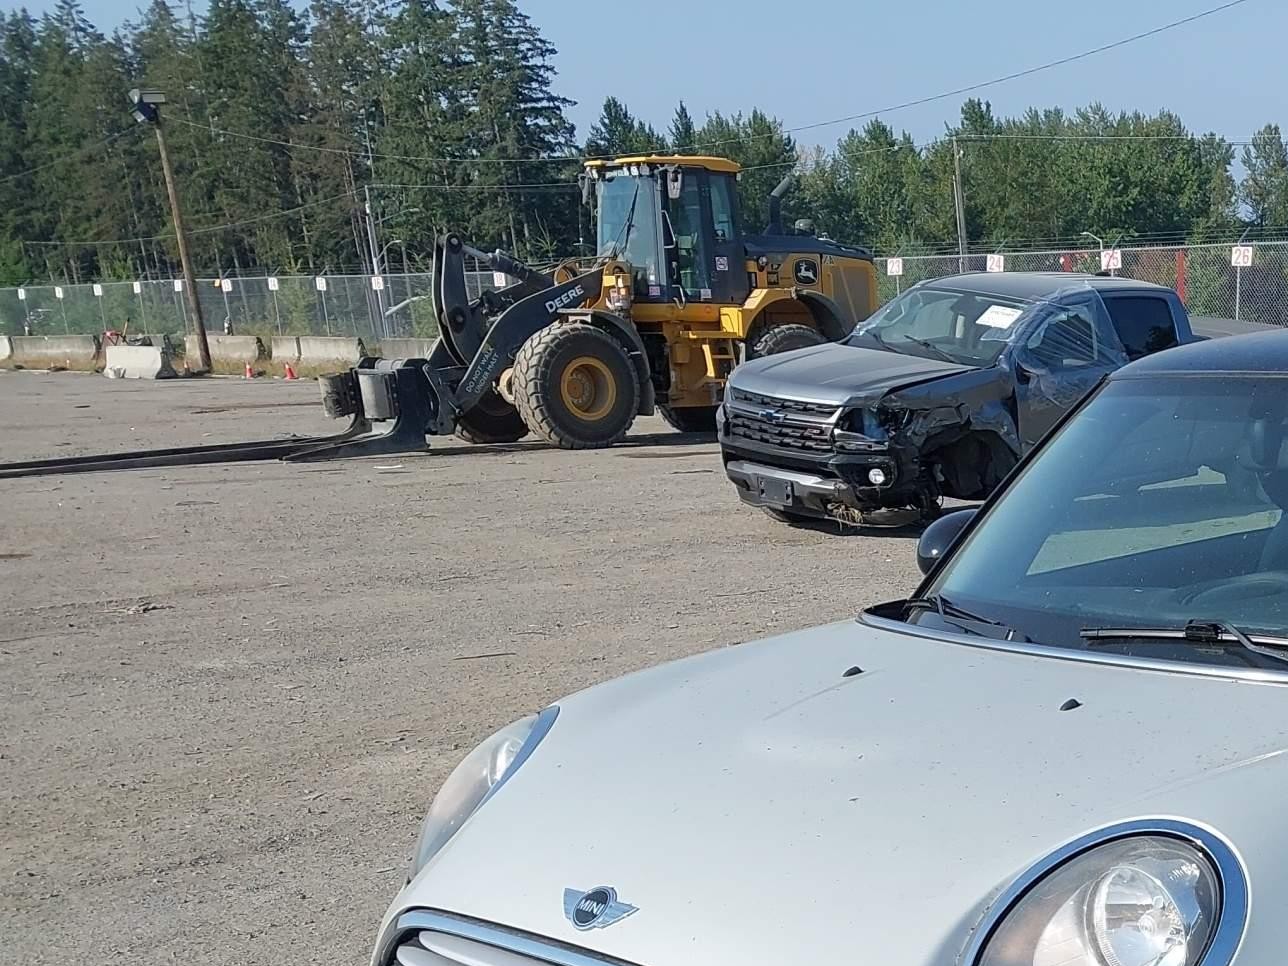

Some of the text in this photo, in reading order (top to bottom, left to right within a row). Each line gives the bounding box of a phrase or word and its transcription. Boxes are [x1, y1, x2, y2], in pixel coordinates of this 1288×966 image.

[988, 257, 1002, 272] 24
[1103, 252, 1120, 268] 25
[1233, 249, 1250, 265] 26
[888, 259, 901, 274] 23
[545, 284, 585, 312] DEERE
[465, 381, 475, 392] DO
[472, 365, 482, 381] NOT
[475, 352, 499, 393] UNDER MAST
[577, 898, 605, 915] MINI
